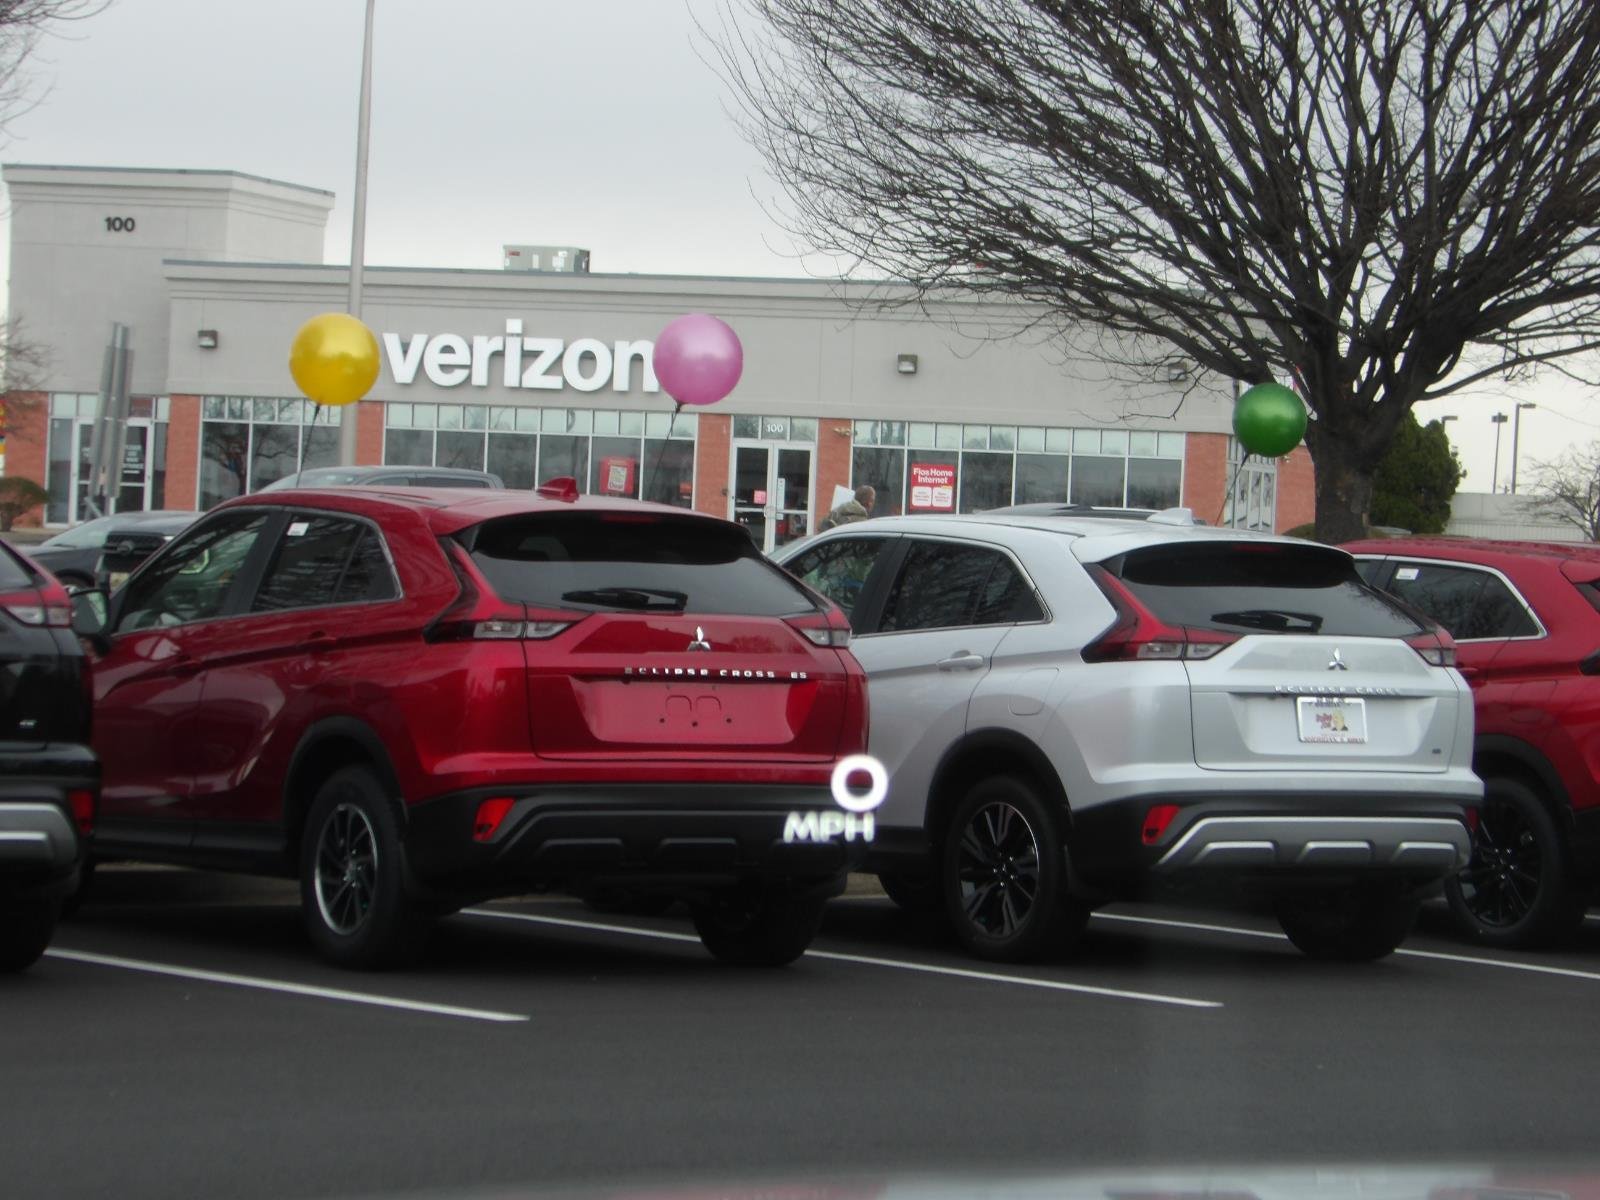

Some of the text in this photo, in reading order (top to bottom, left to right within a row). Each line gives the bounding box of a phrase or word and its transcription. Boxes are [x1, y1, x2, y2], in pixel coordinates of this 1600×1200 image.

[104, 216, 135, 232] 100
[382, 318, 660, 392] verizon
[766, 423, 784, 433] 100
[913, 467, 953, 478] Fios Home
[917, 475, 948, 484] Internet
[719, 669, 775, 679] CROSS
[783, 811, 875, 843] MPH
